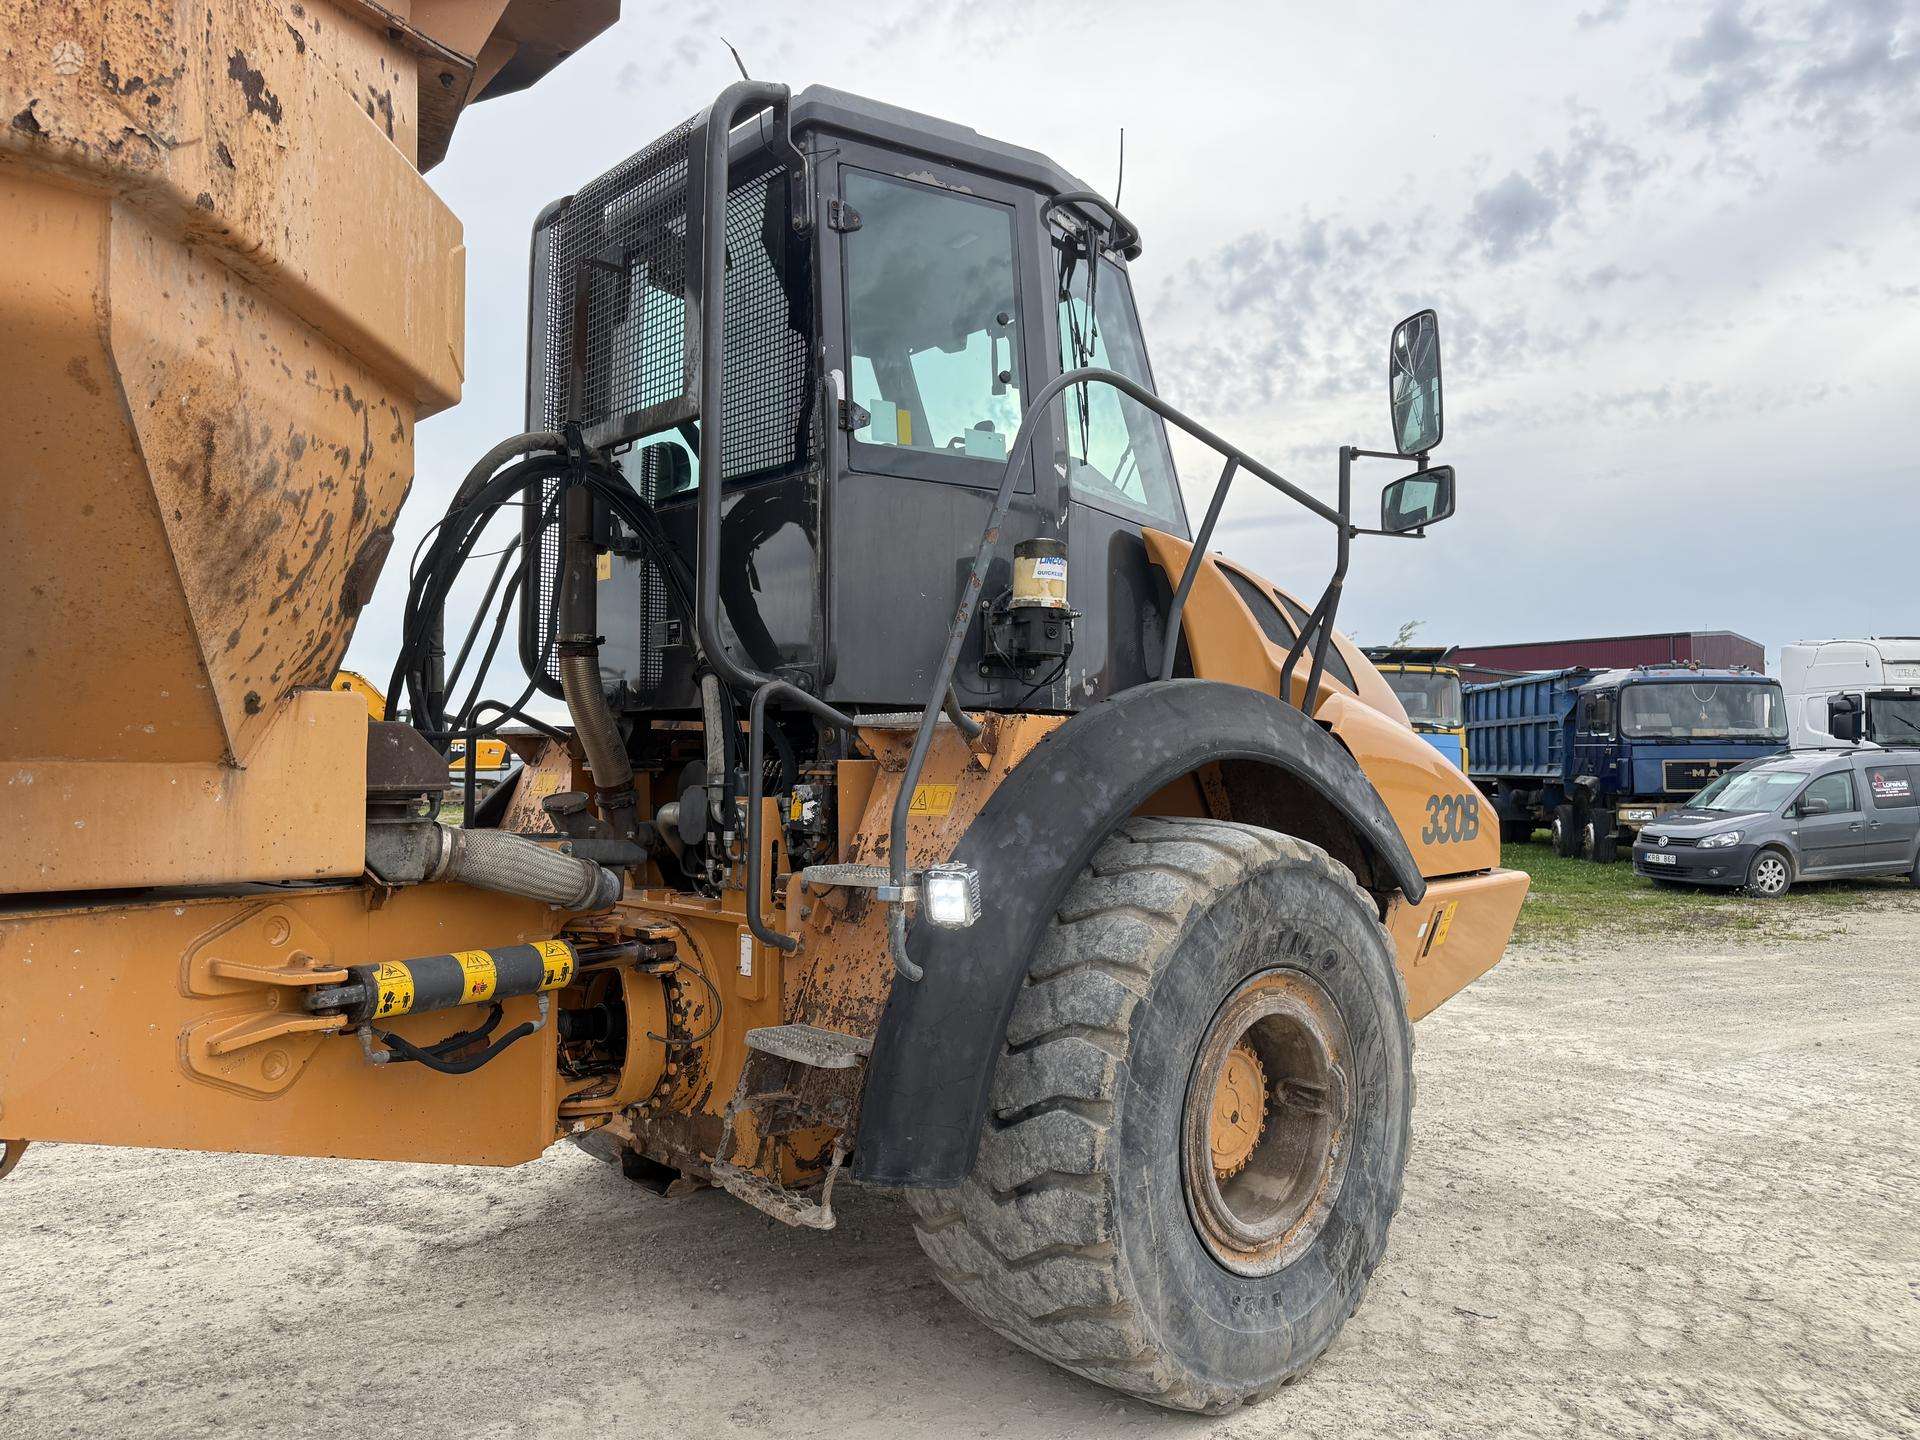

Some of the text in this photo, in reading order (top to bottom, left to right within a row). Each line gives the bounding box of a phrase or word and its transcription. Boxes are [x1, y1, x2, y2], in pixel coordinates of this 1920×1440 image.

[450, 743, 465, 752] JC
[1422, 794, 1479, 845] 330B
[1648, 853, 1660, 862] KRB
